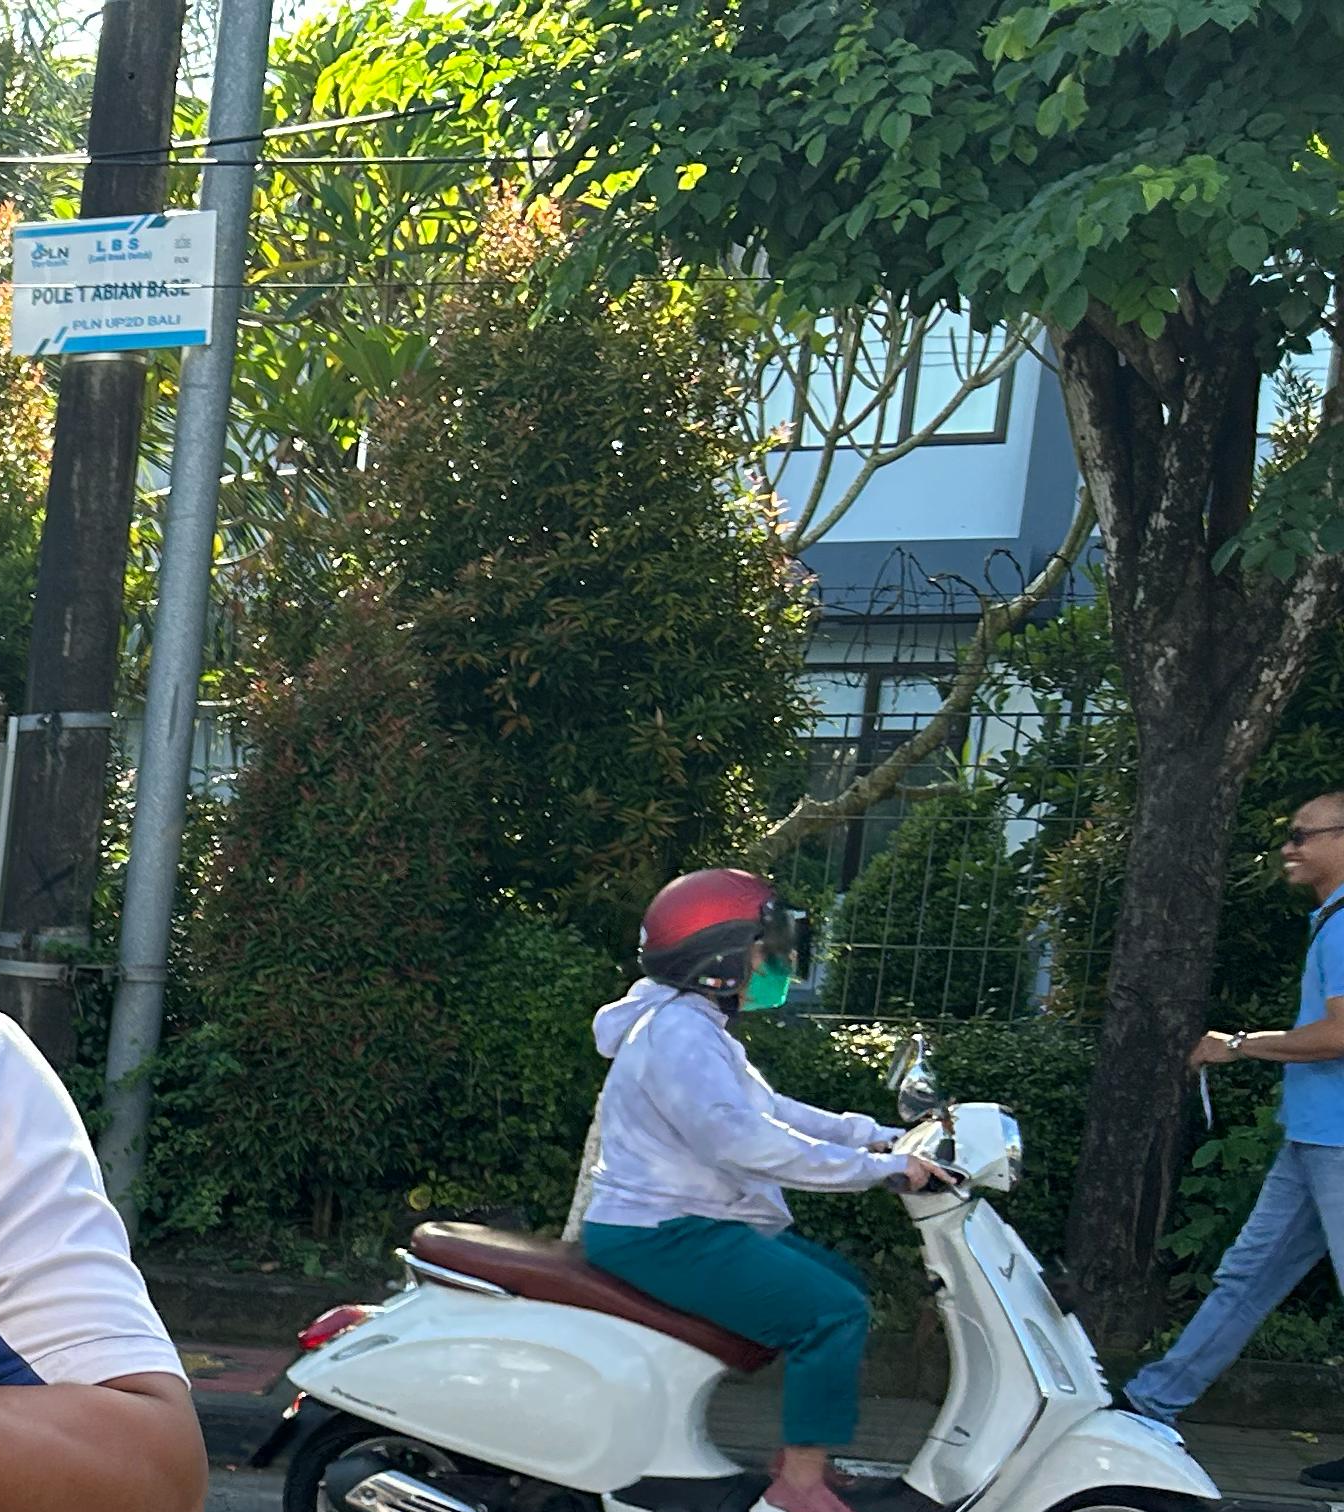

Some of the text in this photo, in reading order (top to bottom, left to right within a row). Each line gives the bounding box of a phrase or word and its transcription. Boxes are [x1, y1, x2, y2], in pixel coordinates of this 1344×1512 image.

[32, 287, 73, 306] POLE
[92, 281, 142, 301] ABIAN
[72, 319, 103, 331] PLN
[148, 314, 181, 327] BALI
